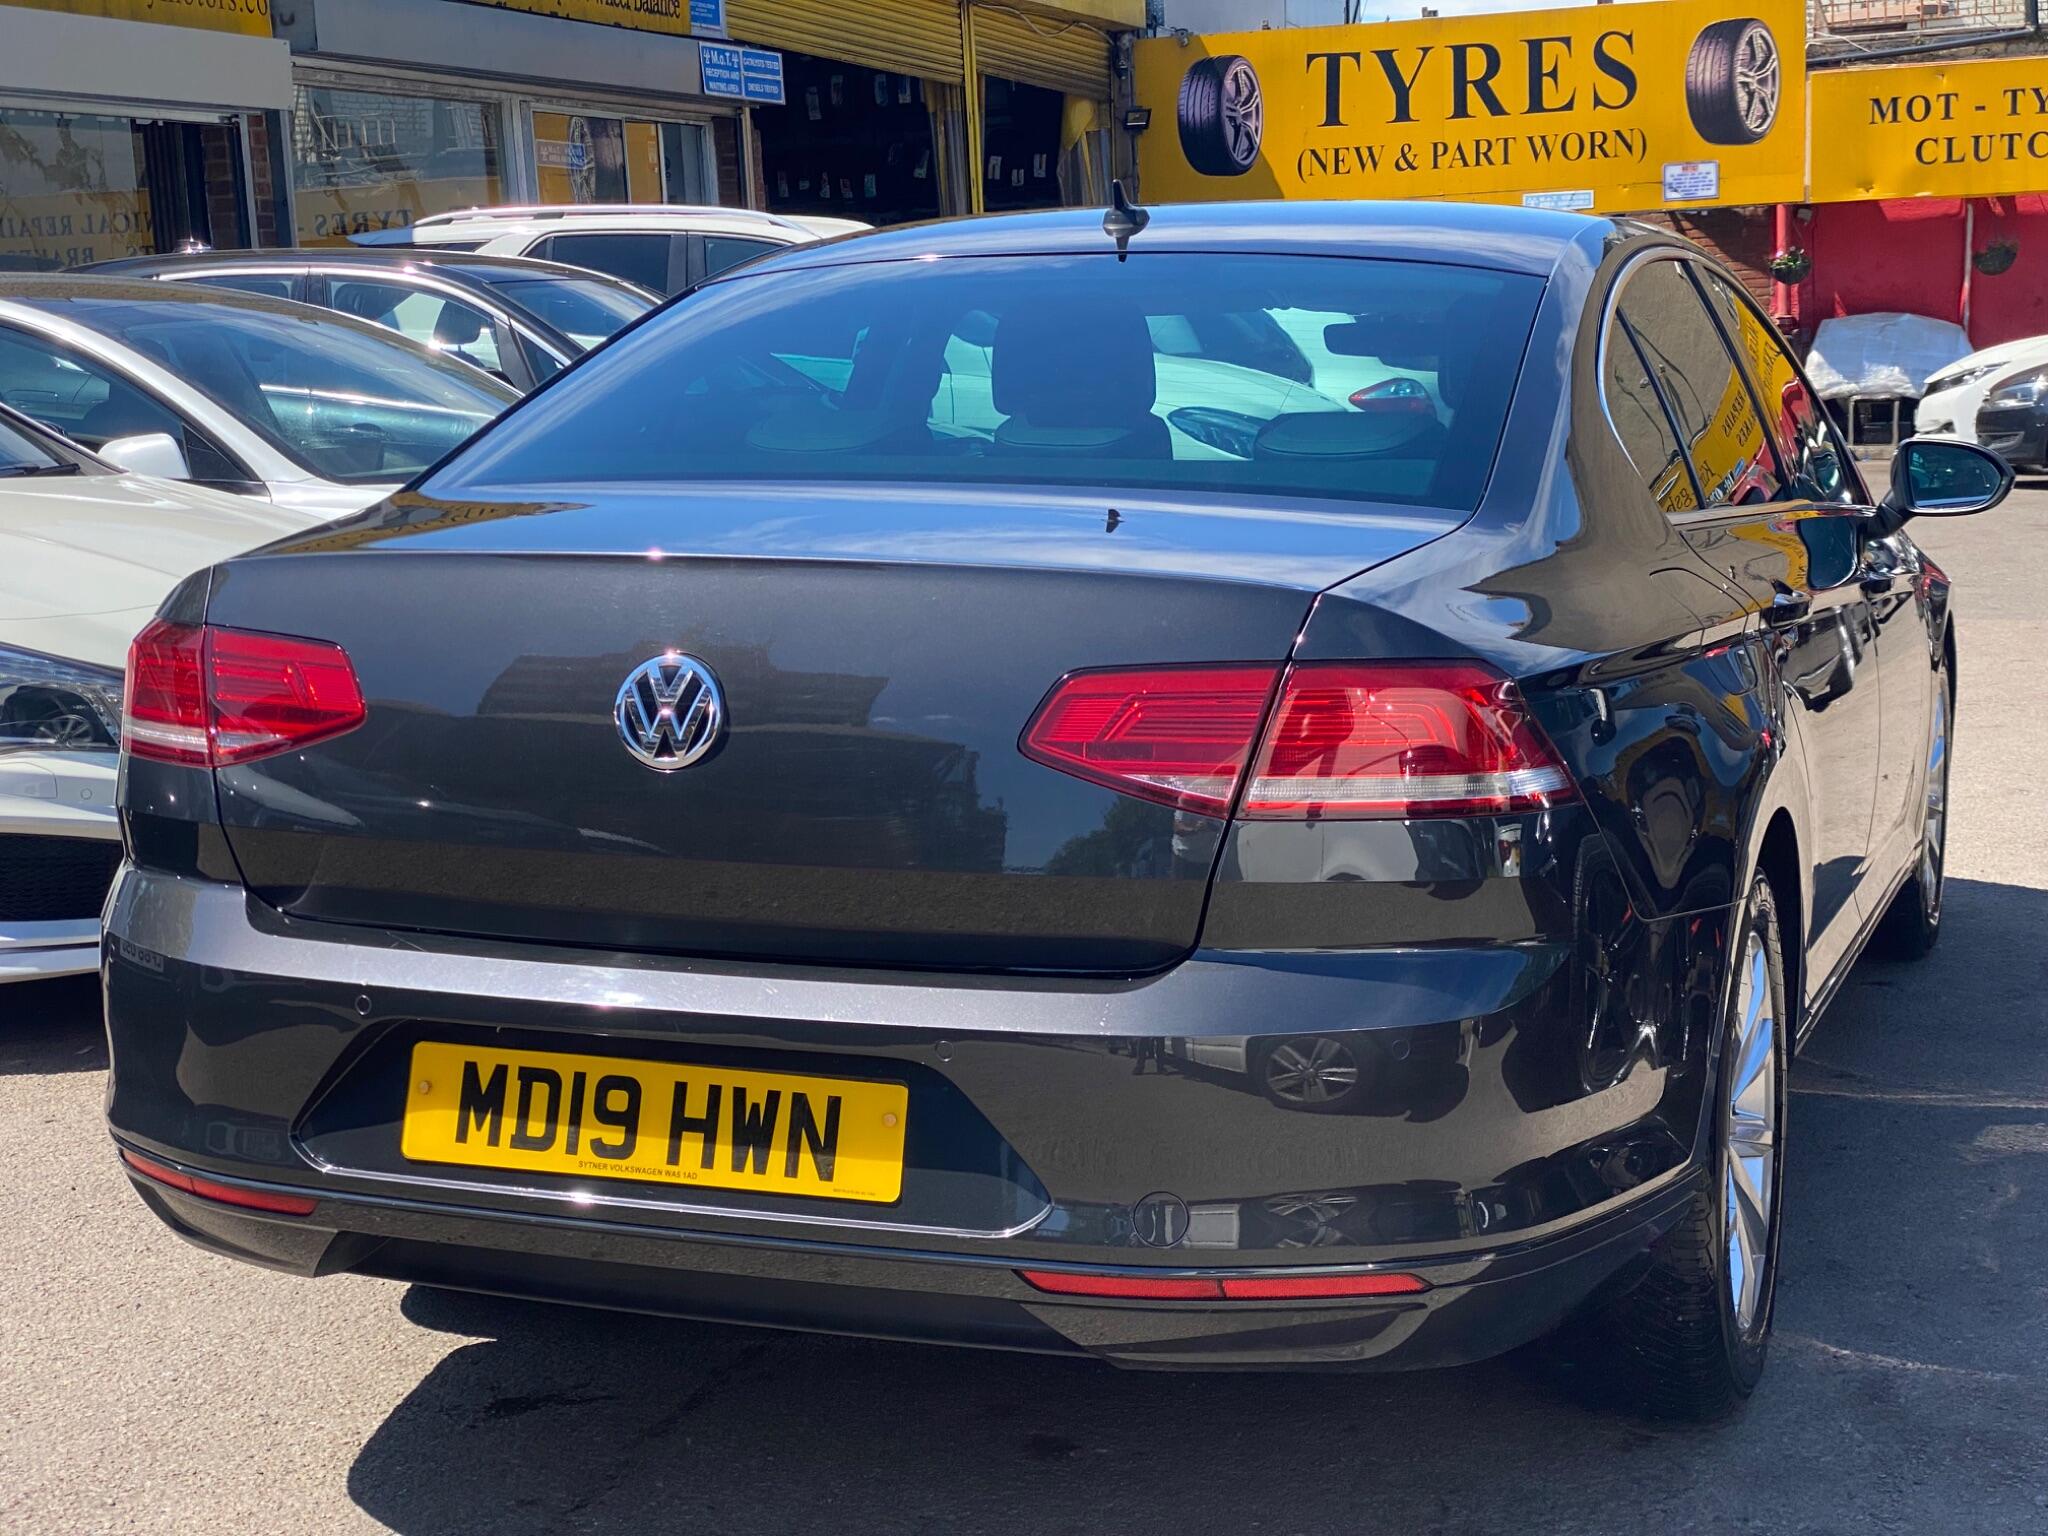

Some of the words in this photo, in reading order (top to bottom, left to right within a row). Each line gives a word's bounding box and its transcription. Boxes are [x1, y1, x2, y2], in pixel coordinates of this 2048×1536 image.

[1306, 30, 1638, 128] TYRES
[1869, 93, 1959, 125] MOT
[1297, 144, 1385, 183] (NEW
[1394, 142, 1419, 172] &
[1431, 137, 1517, 170] PART
[1526, 127, 1647, 164] WORN)
[1915, 130, 2048, 165] CLUTC
[614, 651, 720, 772] VW
[455, 1060, 643, 1160] MD19
[665, 1081, 843, 1183] HWN
[578, 1160, 608, 1170] SYTNER
[610, 1163, 663, 1177] VOLKSWAGEN
